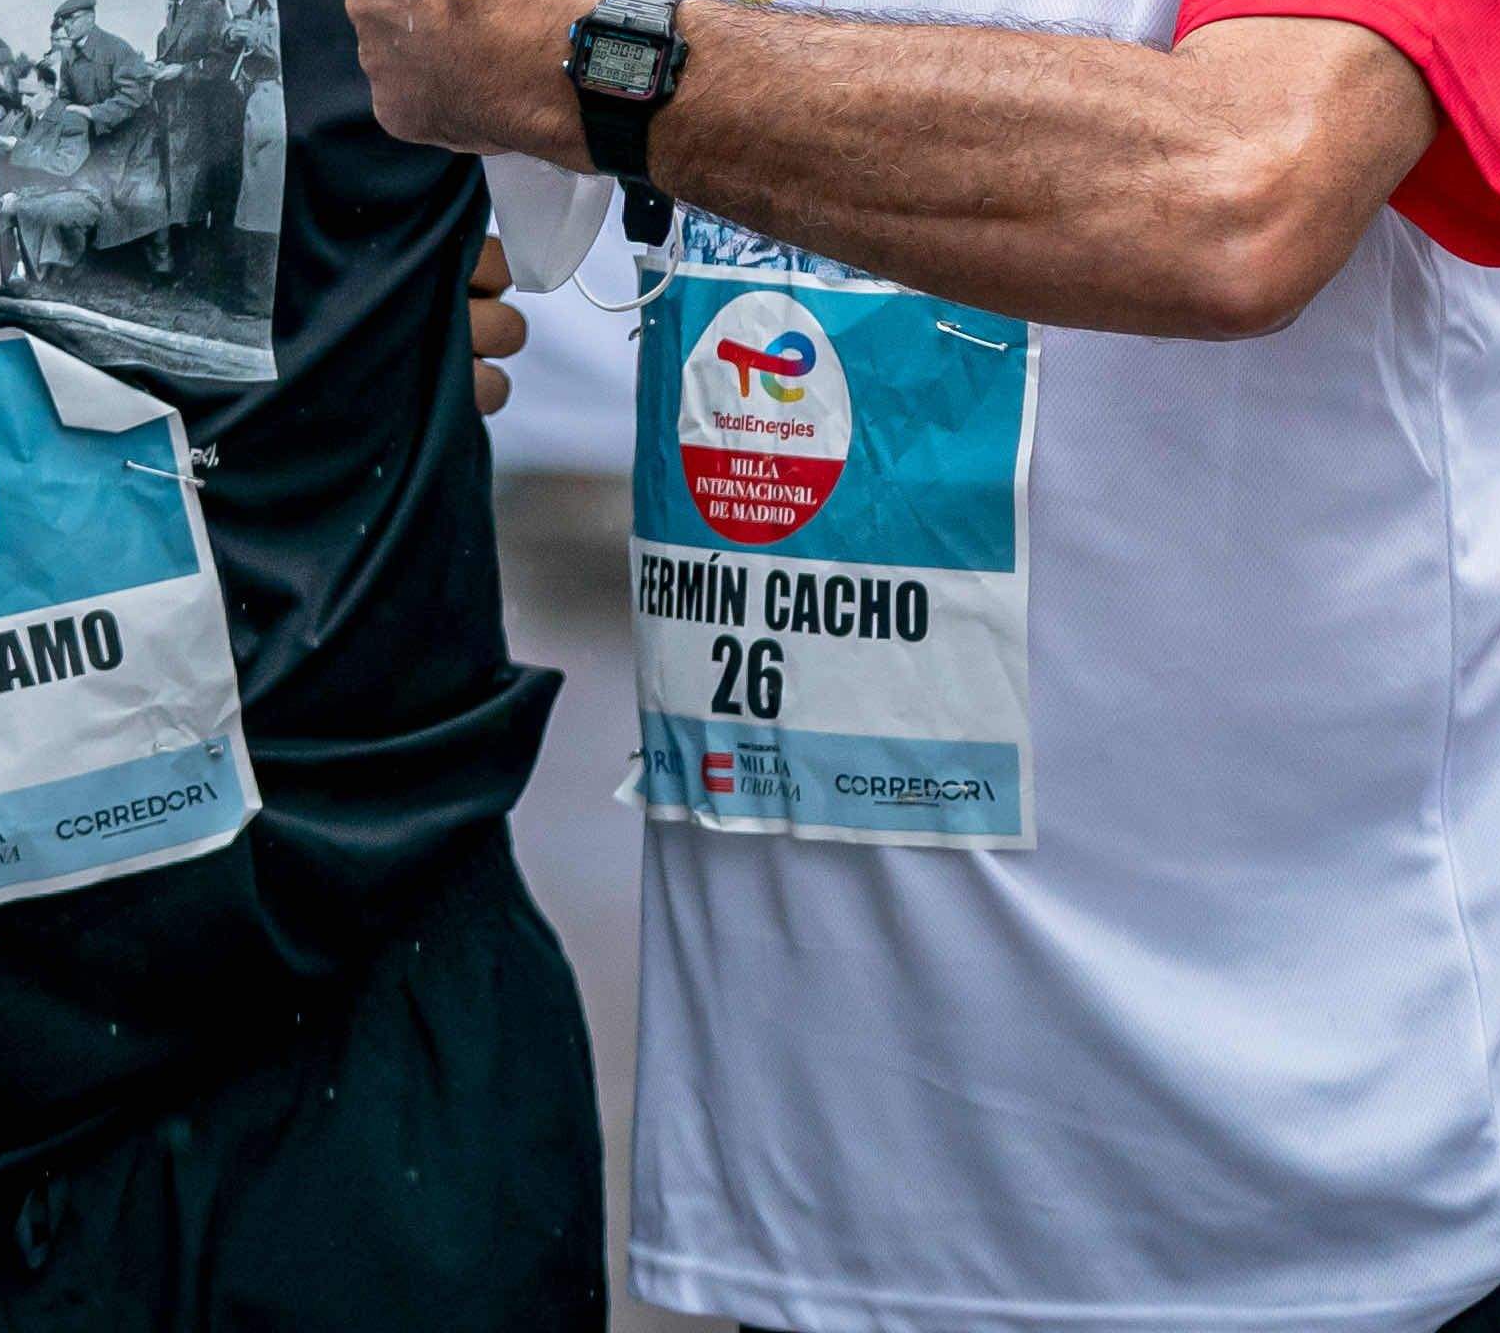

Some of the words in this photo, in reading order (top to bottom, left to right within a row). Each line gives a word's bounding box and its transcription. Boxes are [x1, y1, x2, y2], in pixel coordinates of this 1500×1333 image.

[712, 411, 815, 440] TotalEnergies
[729, 456, 780, 480] MILLA
[708, 499, 730, 520] DE
[731, 501, 797, 527] MADRID
[639, 552, 748, 627] FERMÍN
[764, 568, 931, 643] CACHO
[711, 633, 786, 720] 26
